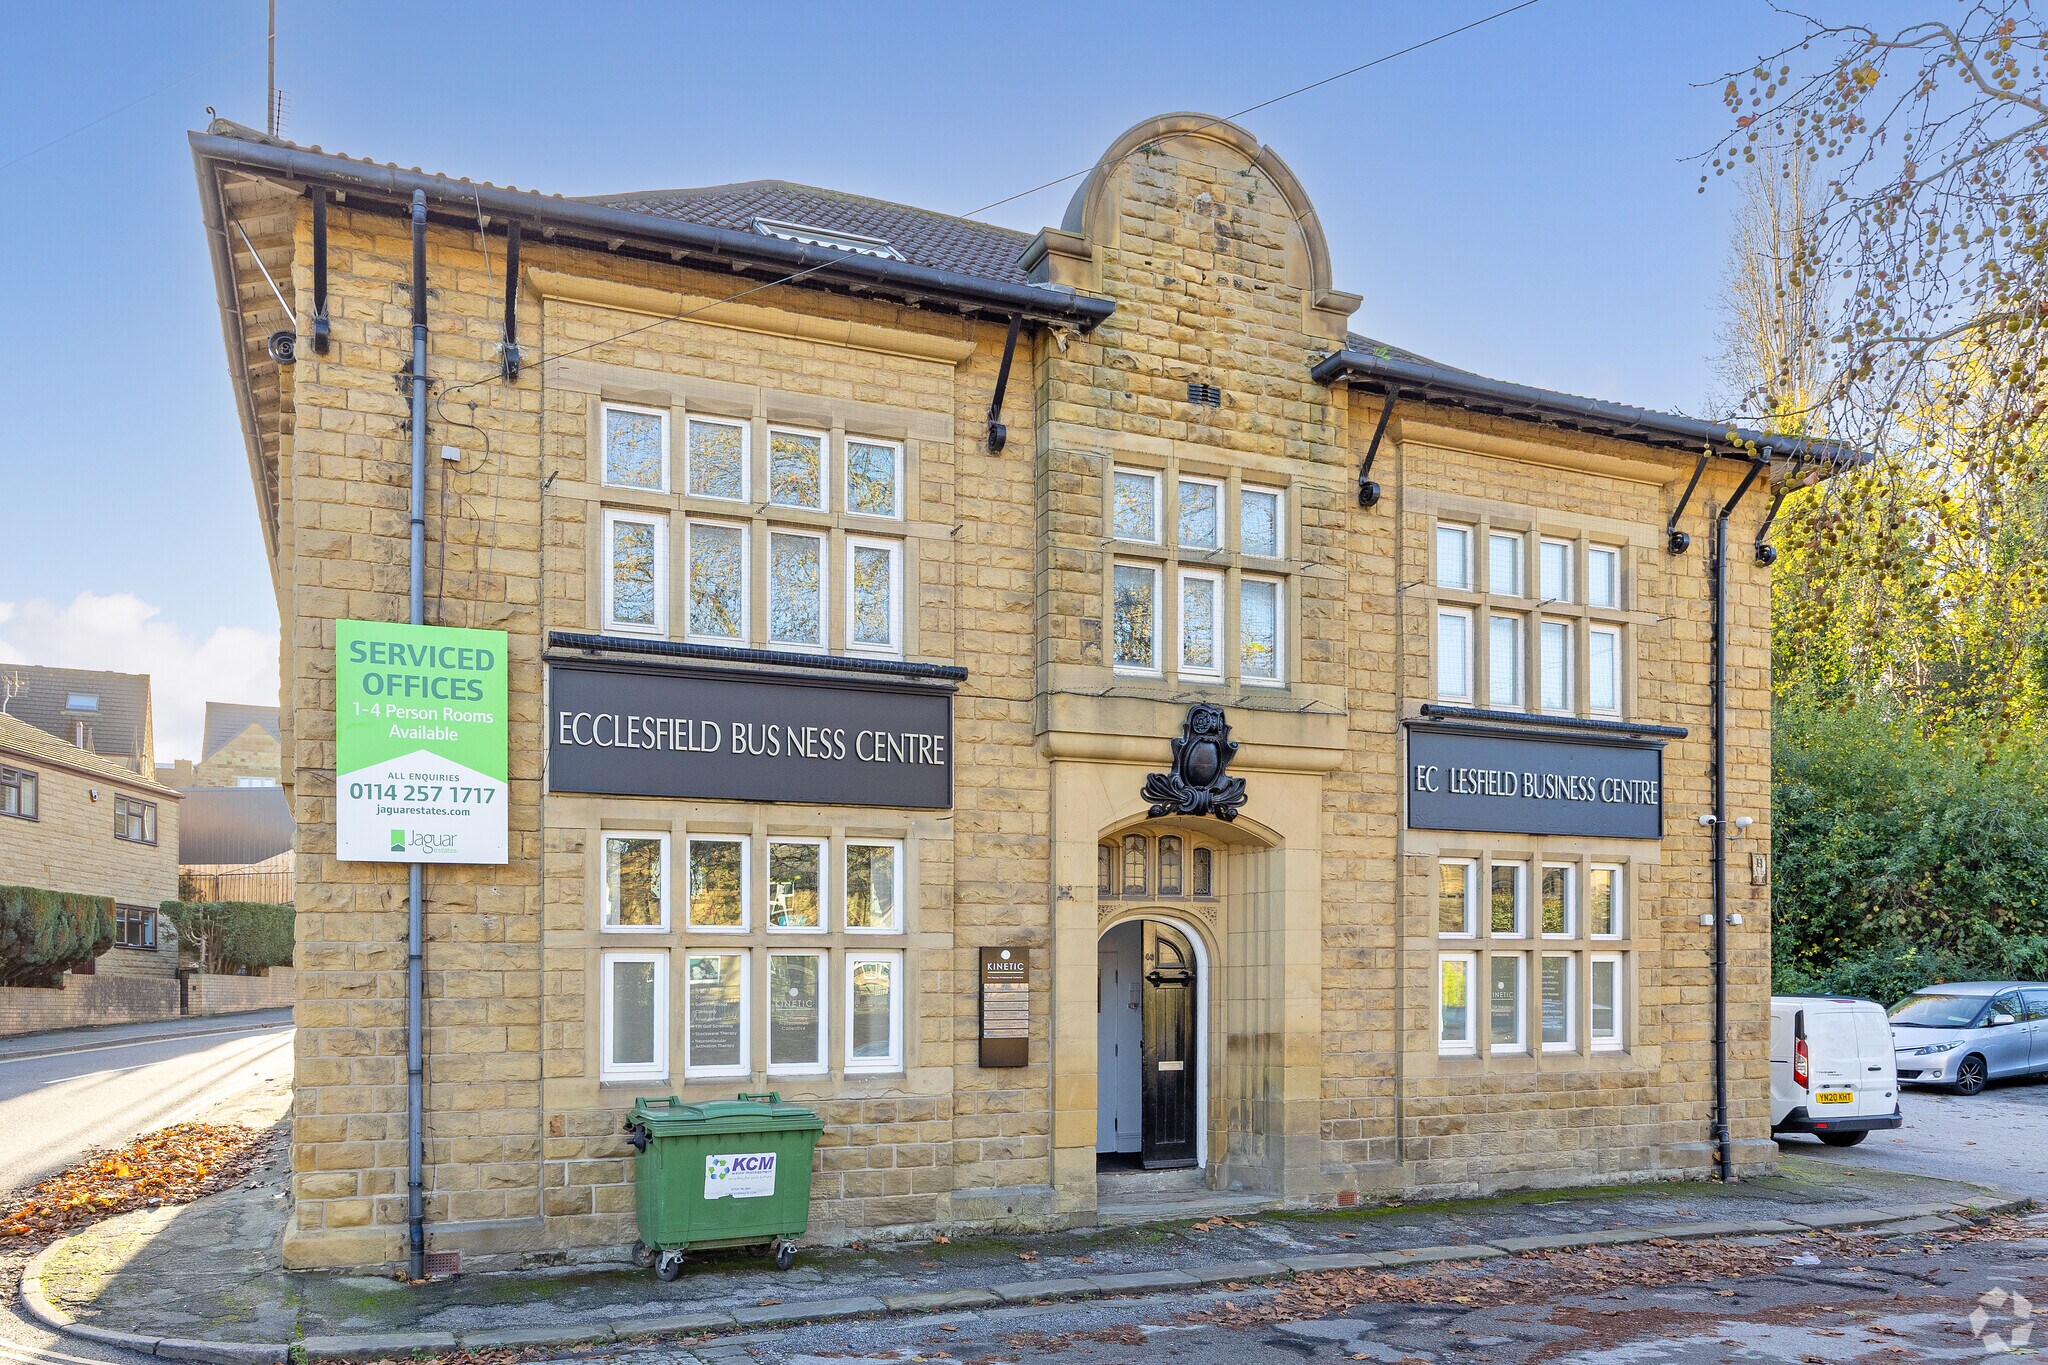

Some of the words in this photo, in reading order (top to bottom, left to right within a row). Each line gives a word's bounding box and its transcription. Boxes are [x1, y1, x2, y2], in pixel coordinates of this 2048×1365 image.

[350, 640, 495, 671] SERVICED
[363, 673, 484, 701] OFFICES
[352, 702, 380, 717] 1-4
[386, 704, 438, 720] Person
[443, 707, 494, 723] Rooms
[389, 724, 458, 741] Available
[559, 711, 722, 753] ECCLESFIELD
[732, 722, 846, 760] BUSNESS
[856, 730, 945, 765] CENTRE
[388, 772, 405, 780] ALL
[409, 773, 460, 782] ENQUIRIES
[1417, 765, 1518, 796] ECLESFIELD
[1524, 772, 1596, 802] BUSINESS
[1601, 778, 1658, 805] CENTRE
[350, 783, 397, 800] 0114
[404, 785, 442, 802] 257
[450, 787, 496, 804] 1717
[376, 804, 470, 816] jaguarestates.com
[408, 829, 458, 854] Jaguar
[987, 962, 1024, 971] KINETIC
[776, 1000, 812, 1008] KINETIC
[1820, 1093, 1837, 1101] YN20
[1839, 1093, 1851, 1101] KHT
[732, 1157, 774, 1171] KCM
